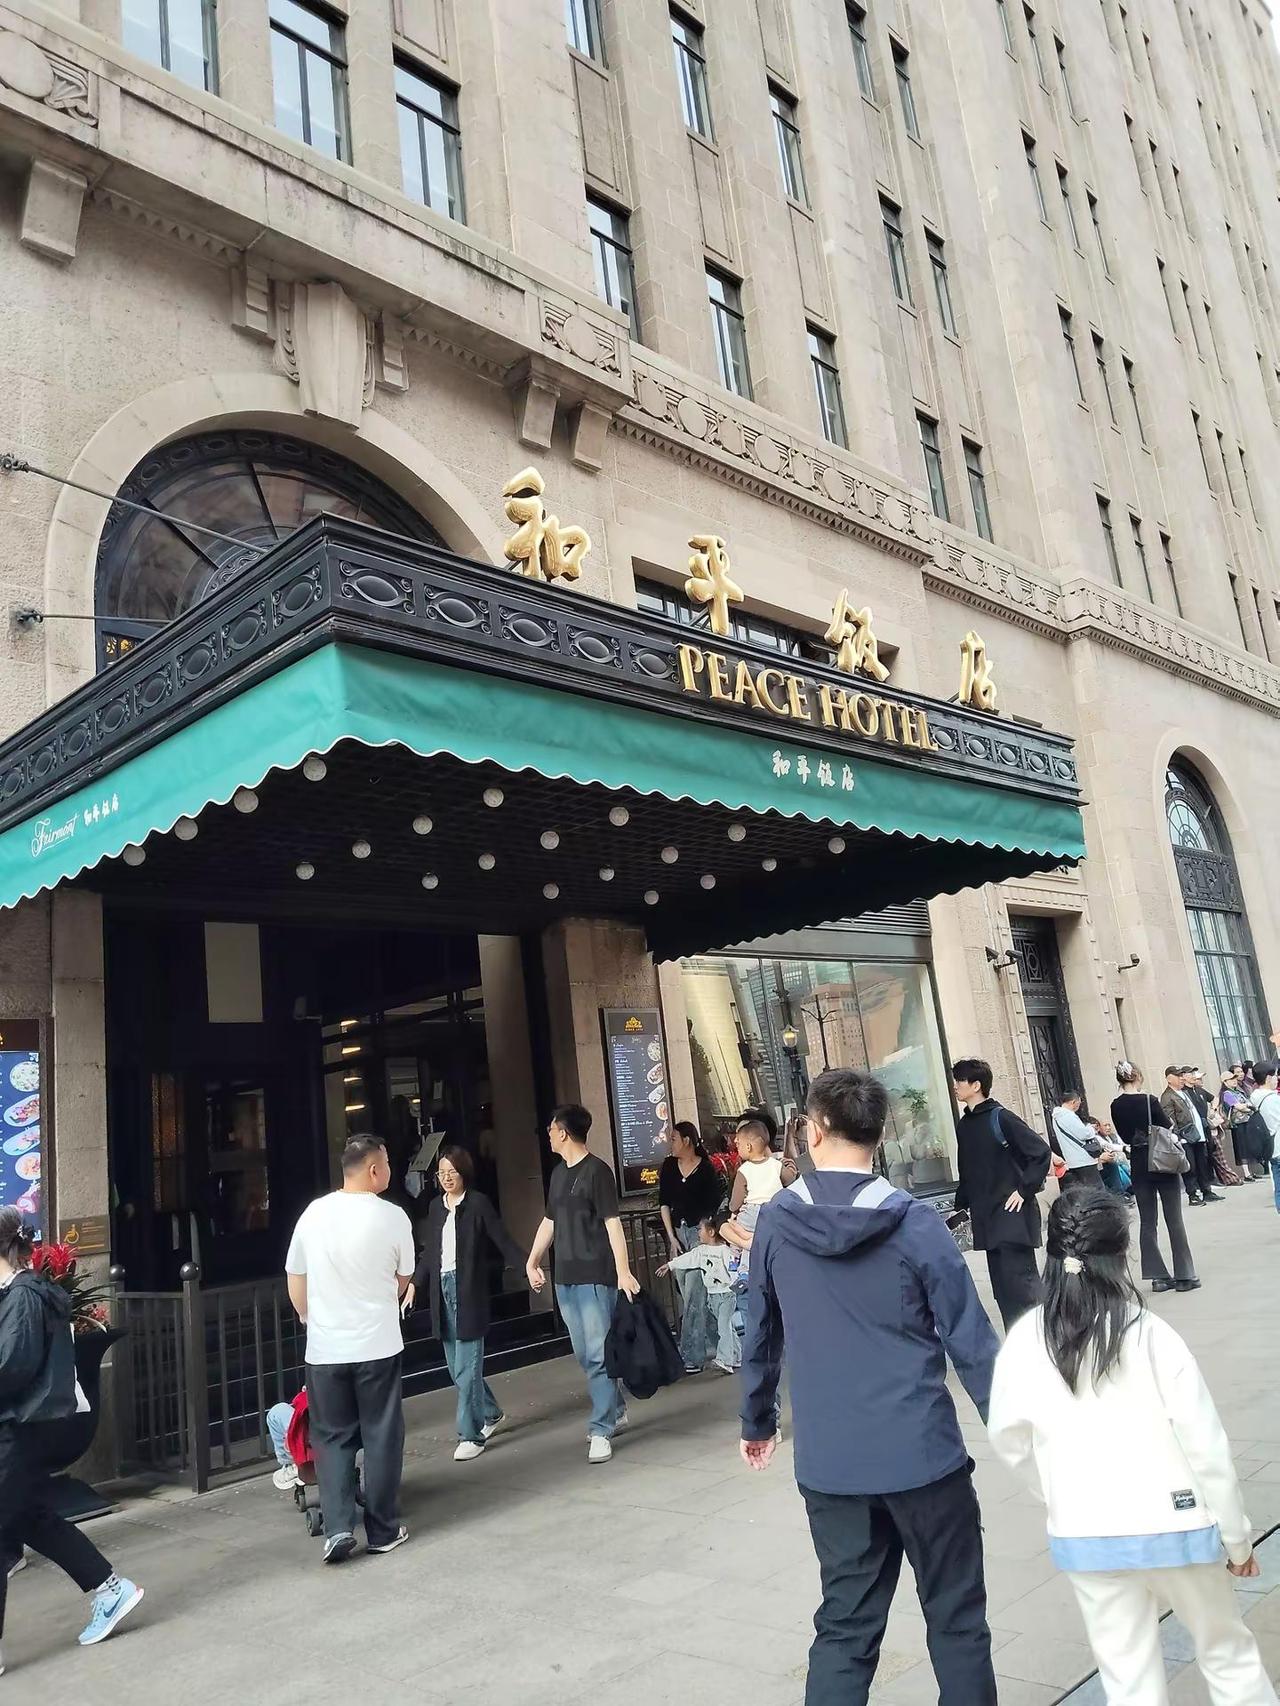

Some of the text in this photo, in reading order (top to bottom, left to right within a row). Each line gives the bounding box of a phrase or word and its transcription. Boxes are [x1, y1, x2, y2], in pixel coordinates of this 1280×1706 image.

[674, 642, 939, 752] PEACE HOTEL
[31, 812, 80, 857] Fairmont
